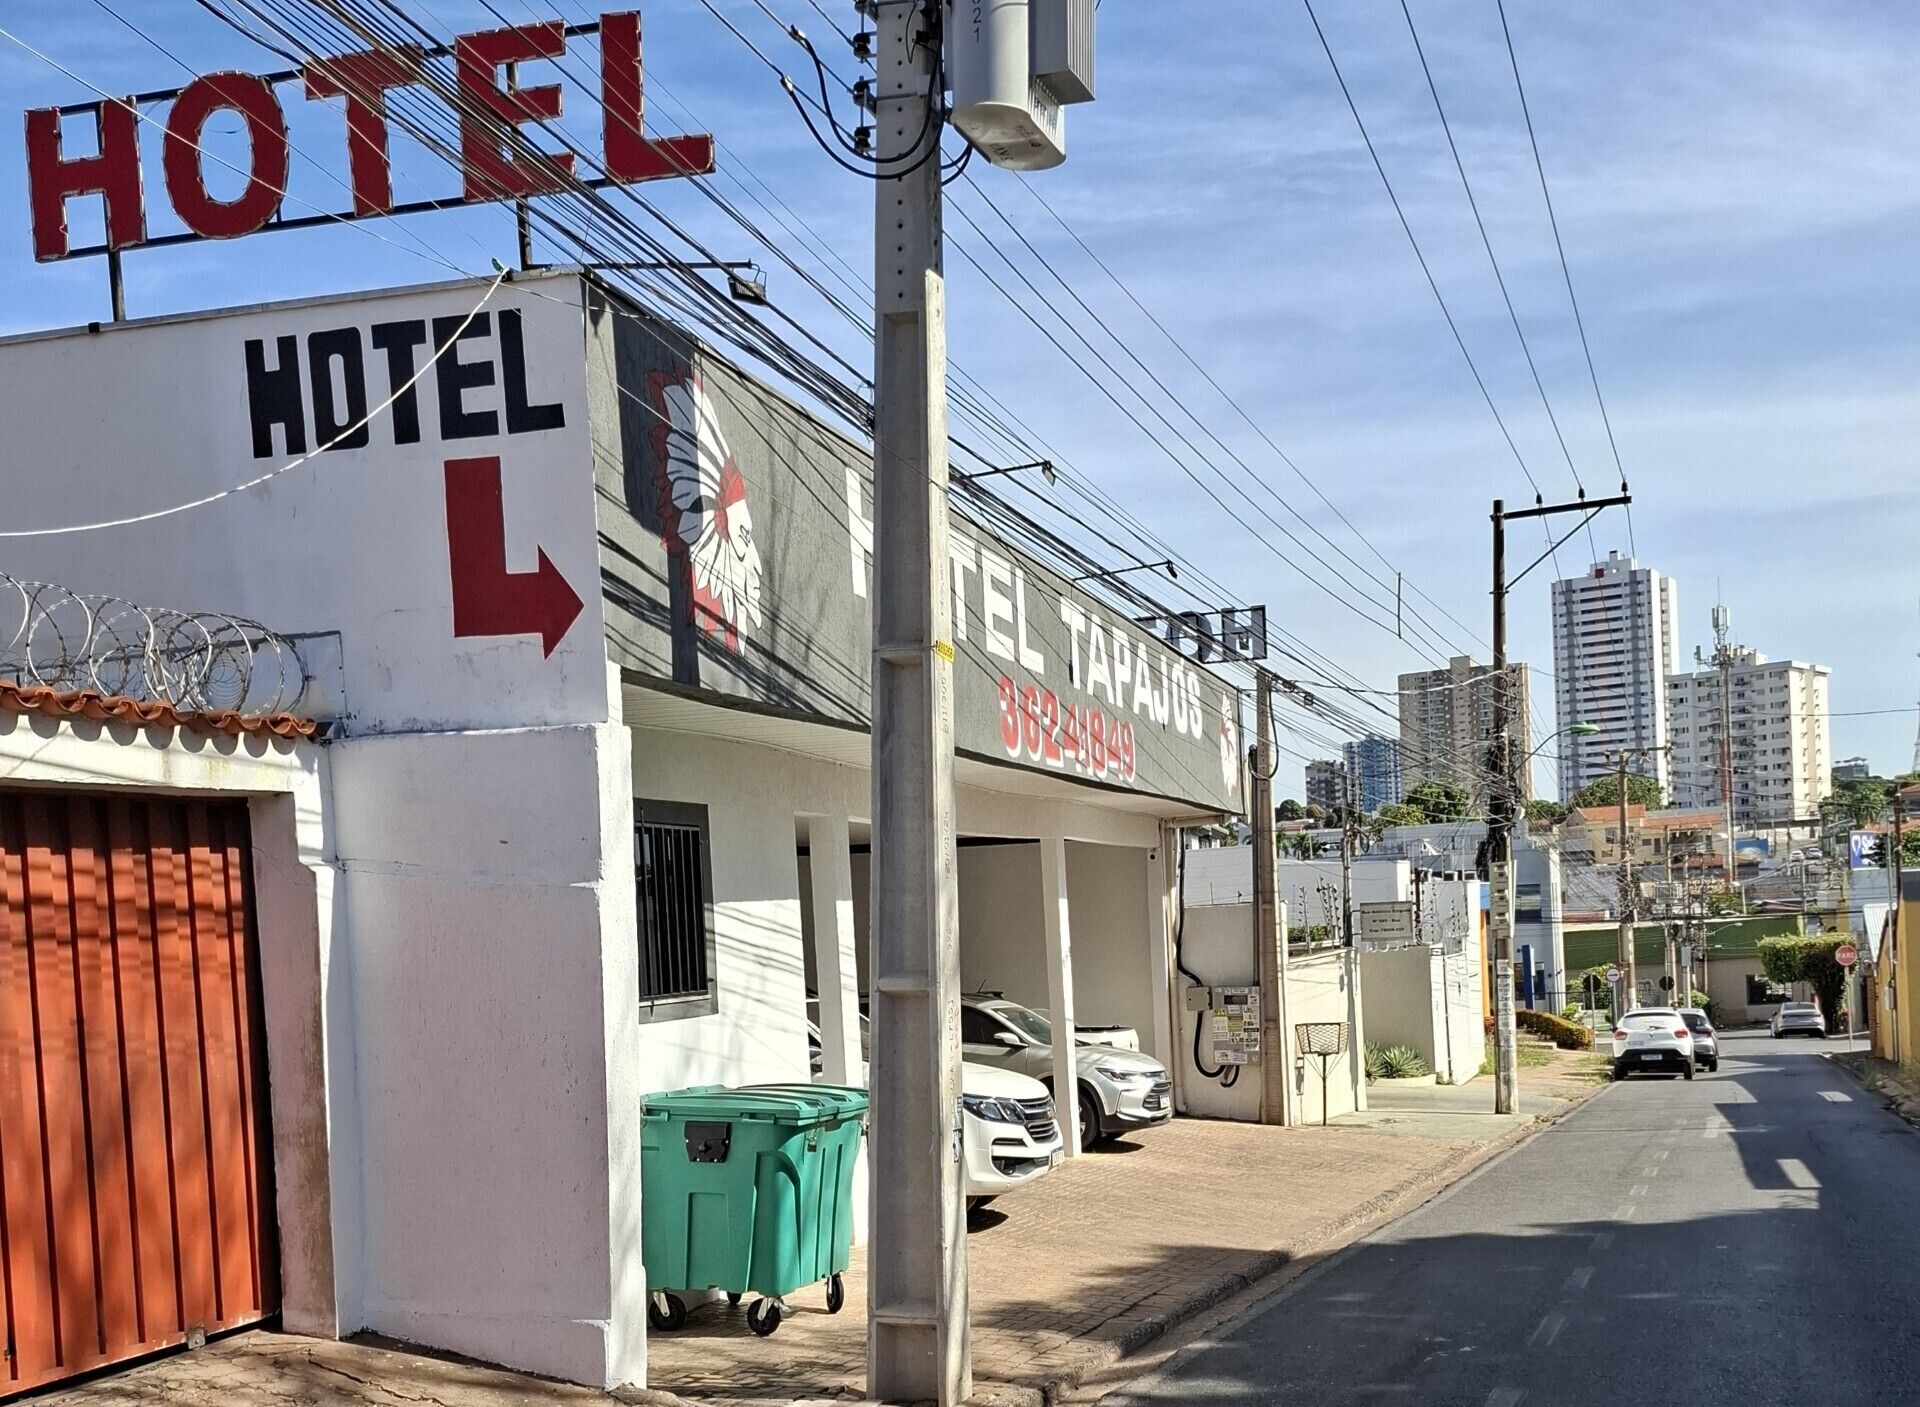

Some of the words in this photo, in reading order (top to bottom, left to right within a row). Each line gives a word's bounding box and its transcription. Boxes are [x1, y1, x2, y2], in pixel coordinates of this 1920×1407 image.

[24, 10, 716, 262] HOTEL
[245, 308, 565, 459] HOTEL
[846, 467, 1045, 675] HTEL
[1060, 595, 1203, 740] TAPAJÓS
